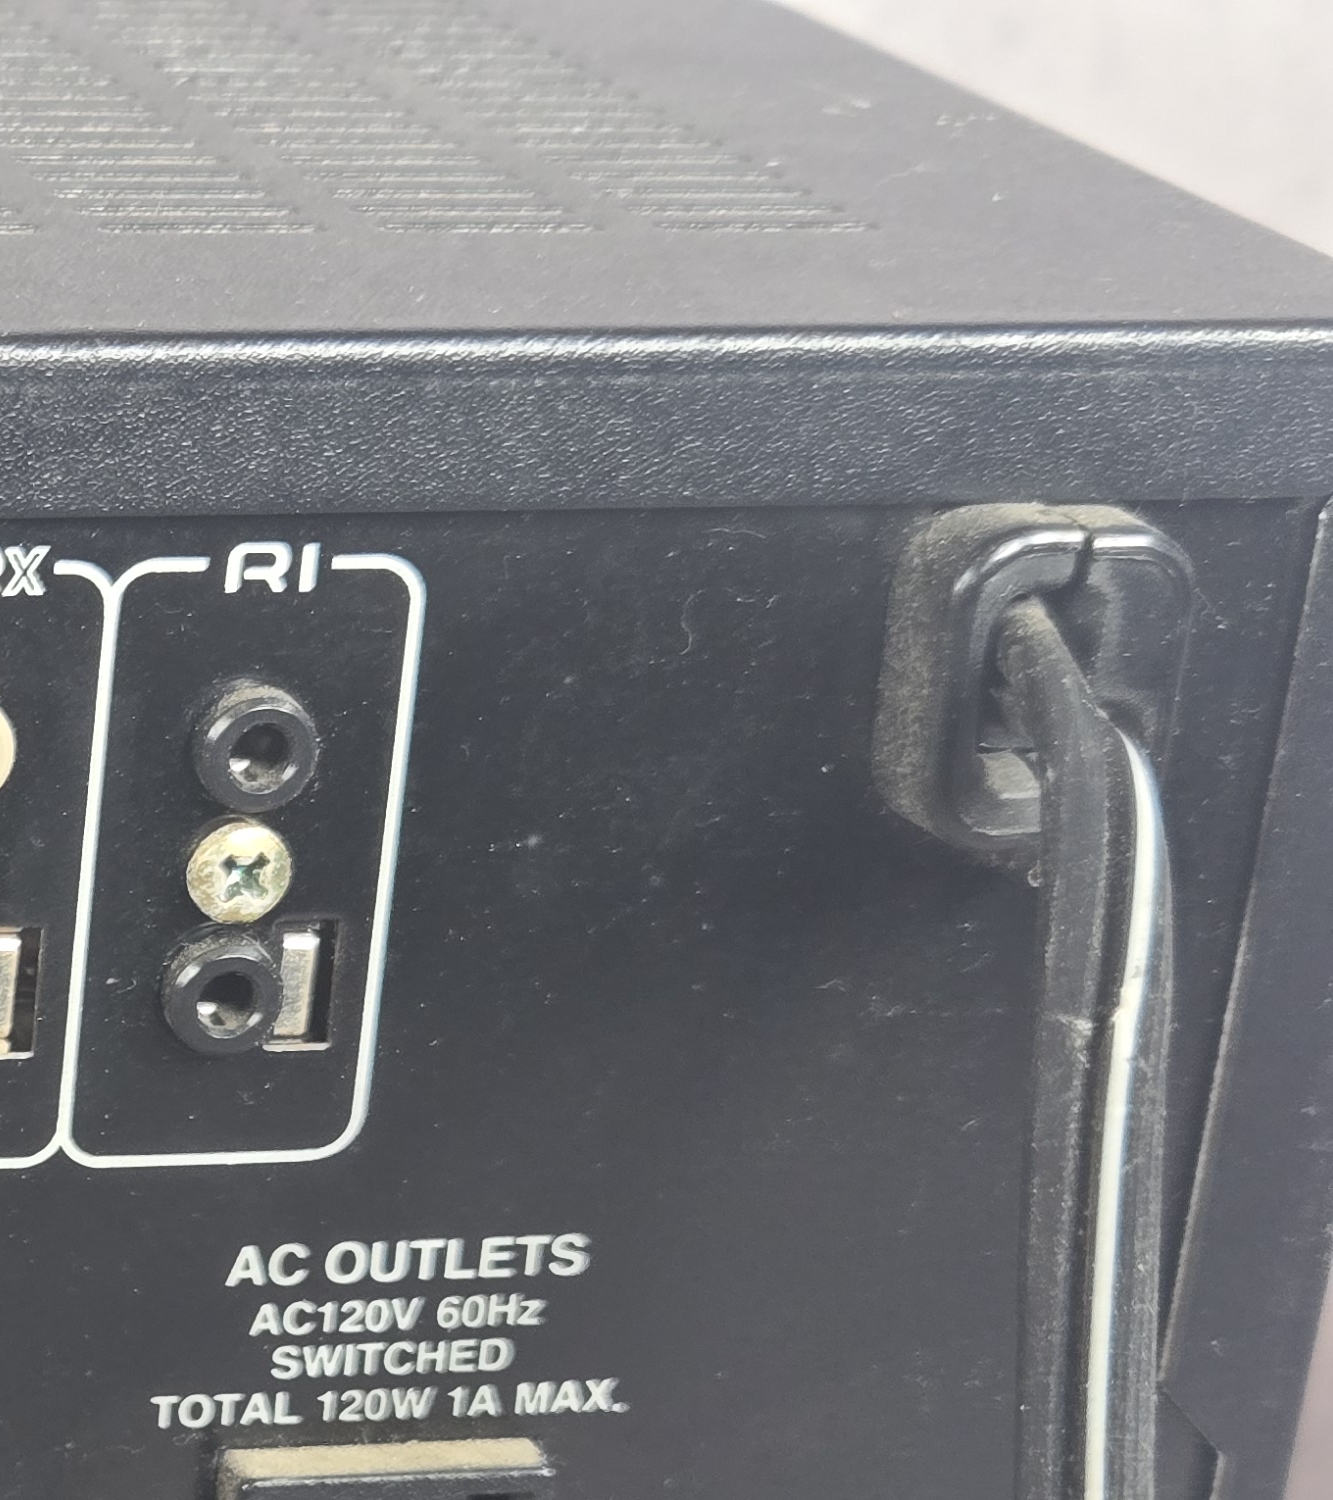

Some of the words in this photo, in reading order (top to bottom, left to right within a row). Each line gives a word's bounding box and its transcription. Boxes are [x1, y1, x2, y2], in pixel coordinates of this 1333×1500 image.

[224, 542, 320, 593] RI
[225, 1243, 310, 1286] AC
[325, 1233, 589, 1284] OUTLETS
[249, 1297, 424, 1336] AC120V
[437, 1294, 546, 1329] 60Hz
[271, 1338, 514, 1379] SWITCHED
[150, 1392, 302, 1429] TOTAL
[317, 1387, 436, 1421] 120W
[448, 1385, 501, 1417] 1A
[515, 1378, 627, 1415] MAX.
